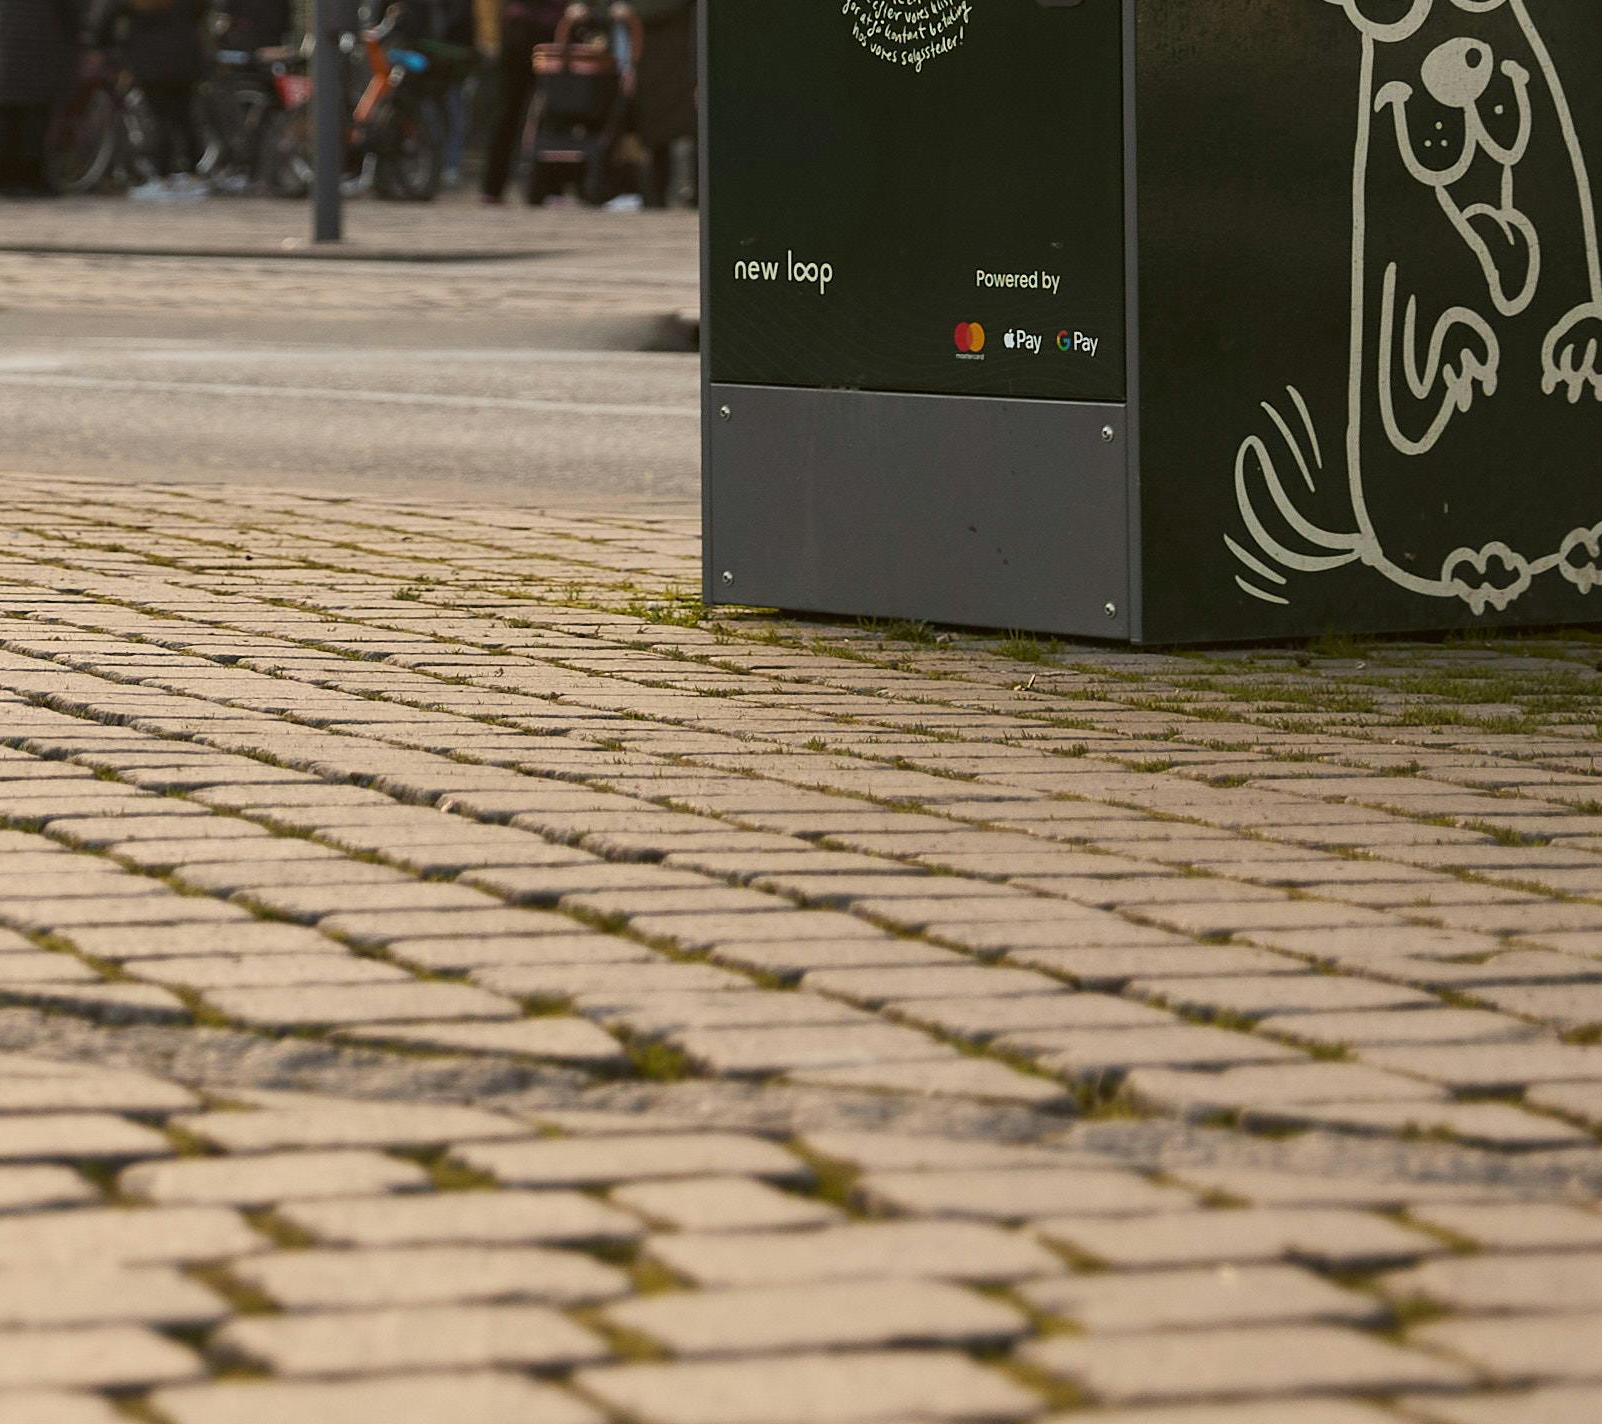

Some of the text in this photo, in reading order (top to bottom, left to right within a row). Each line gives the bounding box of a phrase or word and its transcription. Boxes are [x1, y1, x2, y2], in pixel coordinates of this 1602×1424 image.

[859, 12, 873, 26] at
[904, 6, 930, 24] vores
[852, 22, 868, 47] hos
[870, 43, 898, 63] vores
[733, 249, 833, 295] new loop
[976, 269, 1061, 295] Powered by
[1016, 329, 1042, 354] Pay
[1073, 330, 1099, 357] Pay
